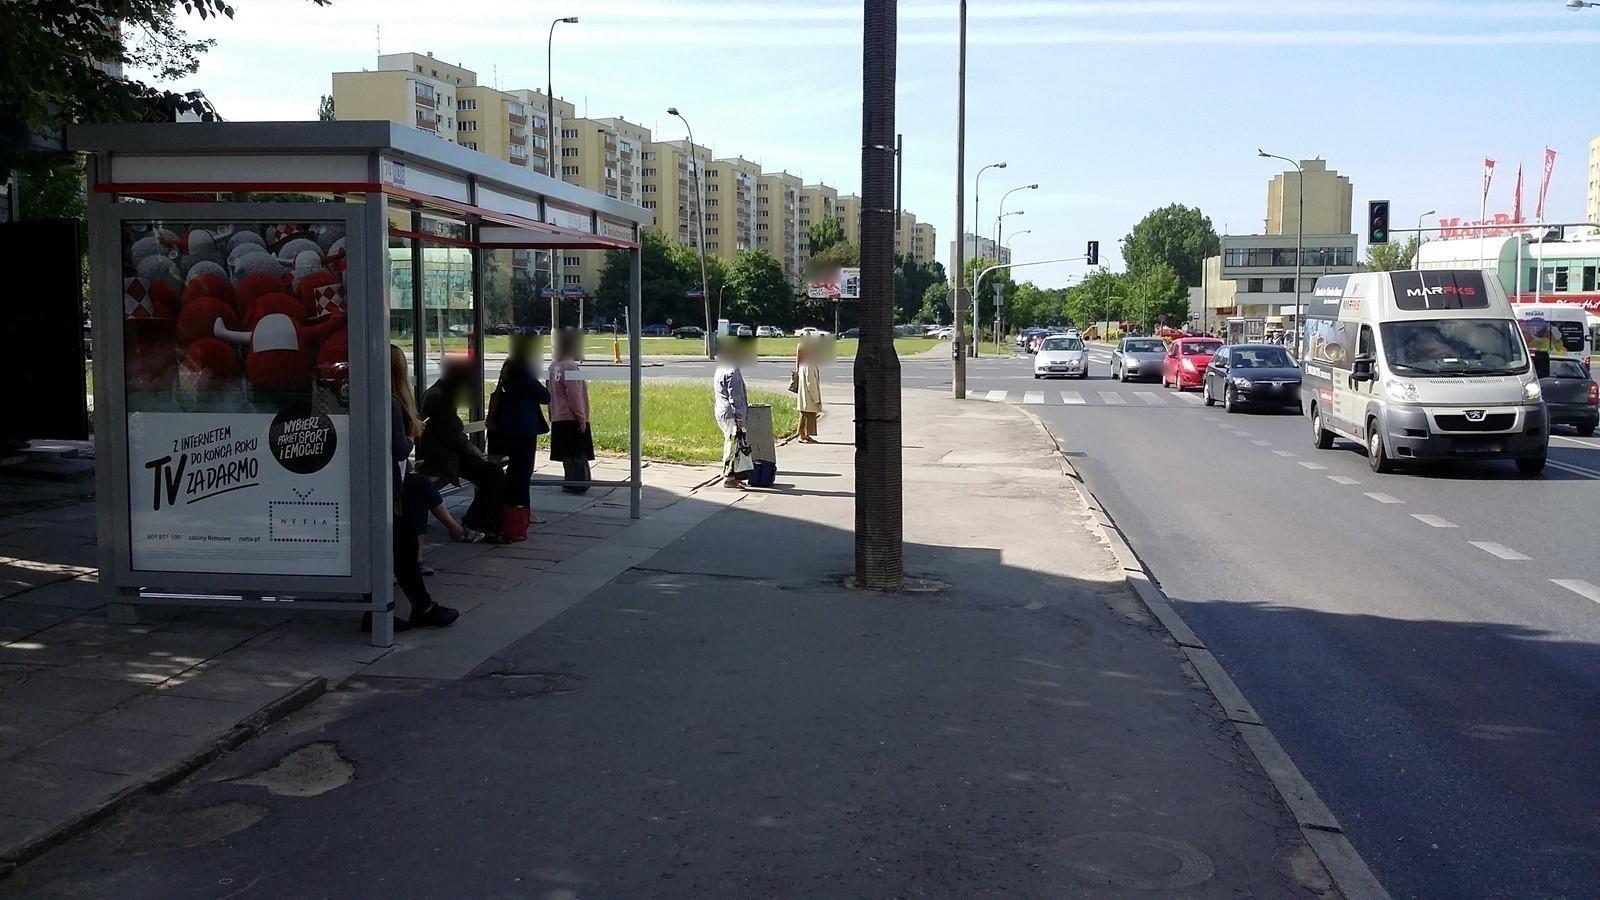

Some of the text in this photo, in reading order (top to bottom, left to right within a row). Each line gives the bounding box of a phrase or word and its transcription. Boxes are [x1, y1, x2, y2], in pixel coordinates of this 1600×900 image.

[172, 425, 231, 453] Z INTERNETEM
[298, 427, 330, 444] SPORT
[190, 437, 258, 465] DO KOŃCA ROKU
[284, 441, 324, 459] EMOCJE!
[145, 453, 188, 511] TV
[280, 518, 328, 526] NETIA
